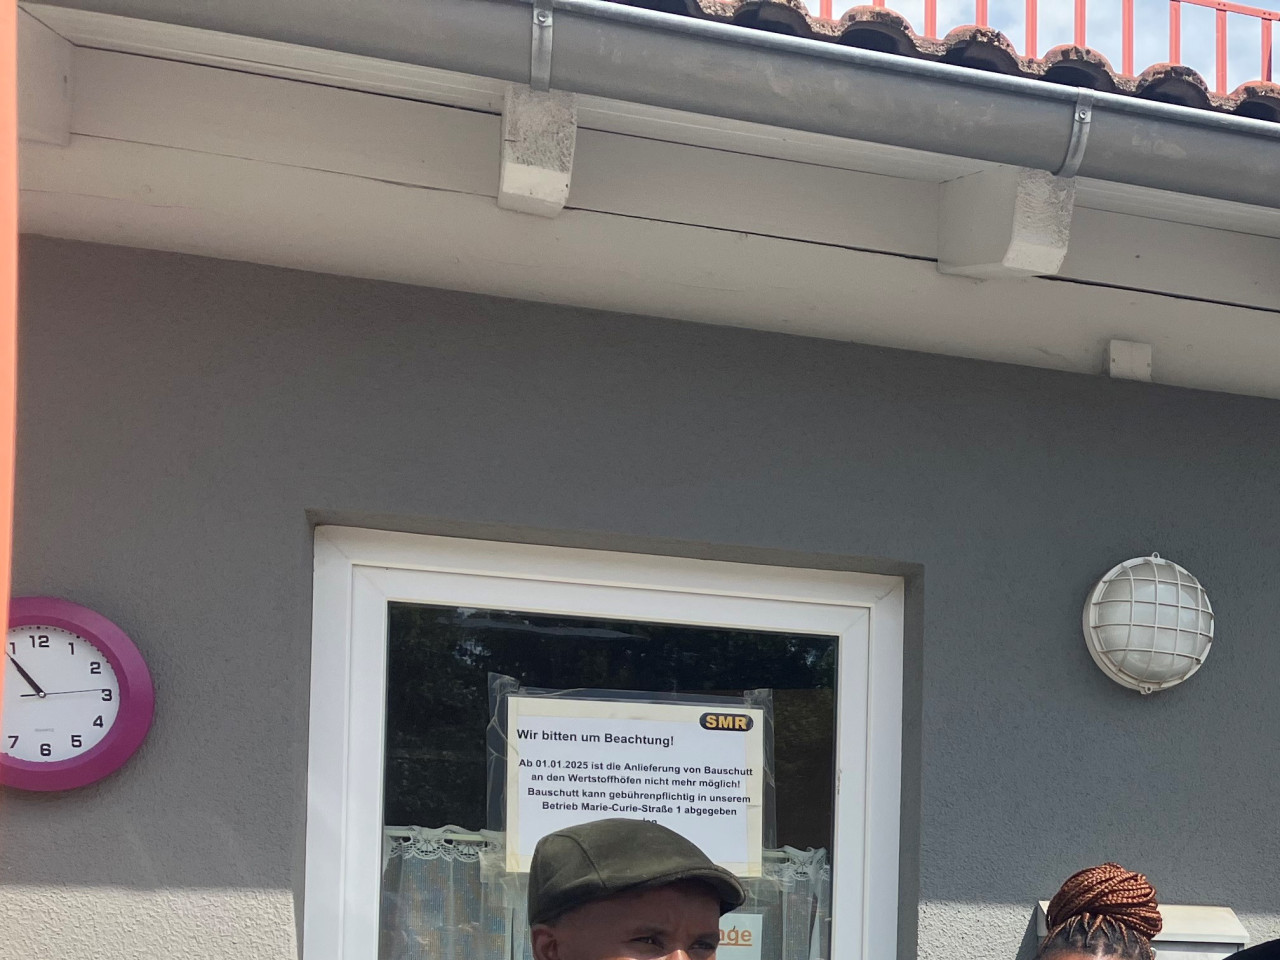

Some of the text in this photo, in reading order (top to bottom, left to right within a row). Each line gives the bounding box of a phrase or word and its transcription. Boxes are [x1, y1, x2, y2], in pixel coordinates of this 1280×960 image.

[29, 635, 50, 648] 12
[68, 642, 75, 655] 1
[90, 662, 101, 674] 2
[101, 689, 113, 701] 3
[93, 716, 104, 728] 4
[705, 715, 747, 729] SMR
[8, 735, 19, 748] 7
[71, 735, 82, 748] 5
[517, 729, 538, 740] Wir
[542, 730, 577, 742] bitten
[604, 733, 674, 748] Beachtung!
[40, 744, 51, 756] 6
[519, 759, 533, 767] Ab
[536, 760, 588, 769] 01.01.2025
[591, 762, 603, 770] ist
[606, 762, 621, 771] die
[624, 763, 680, 774] Anlieferung
[704, 766, 753, 776] Bauschutt
[547, 773, 565, 782] den
[568, 774, 641, 784] Wertstoffhöfen
[644, 777, 669, 786] nicht
[672, 779, 697, 787] mehr
[699, 779, 740, 789] möglich!
[528, 787, 579, 798] Bauschutt
[582, 789, 606, 798] kann
[609, 791, 695, 802] gebührenpflichtig
[698, 794, 707, 802] in
[542, 801, 737, 817] Betrieb Marie-Curie-Straße 1 abgegeben
[719, 929, 752, 945] nge
